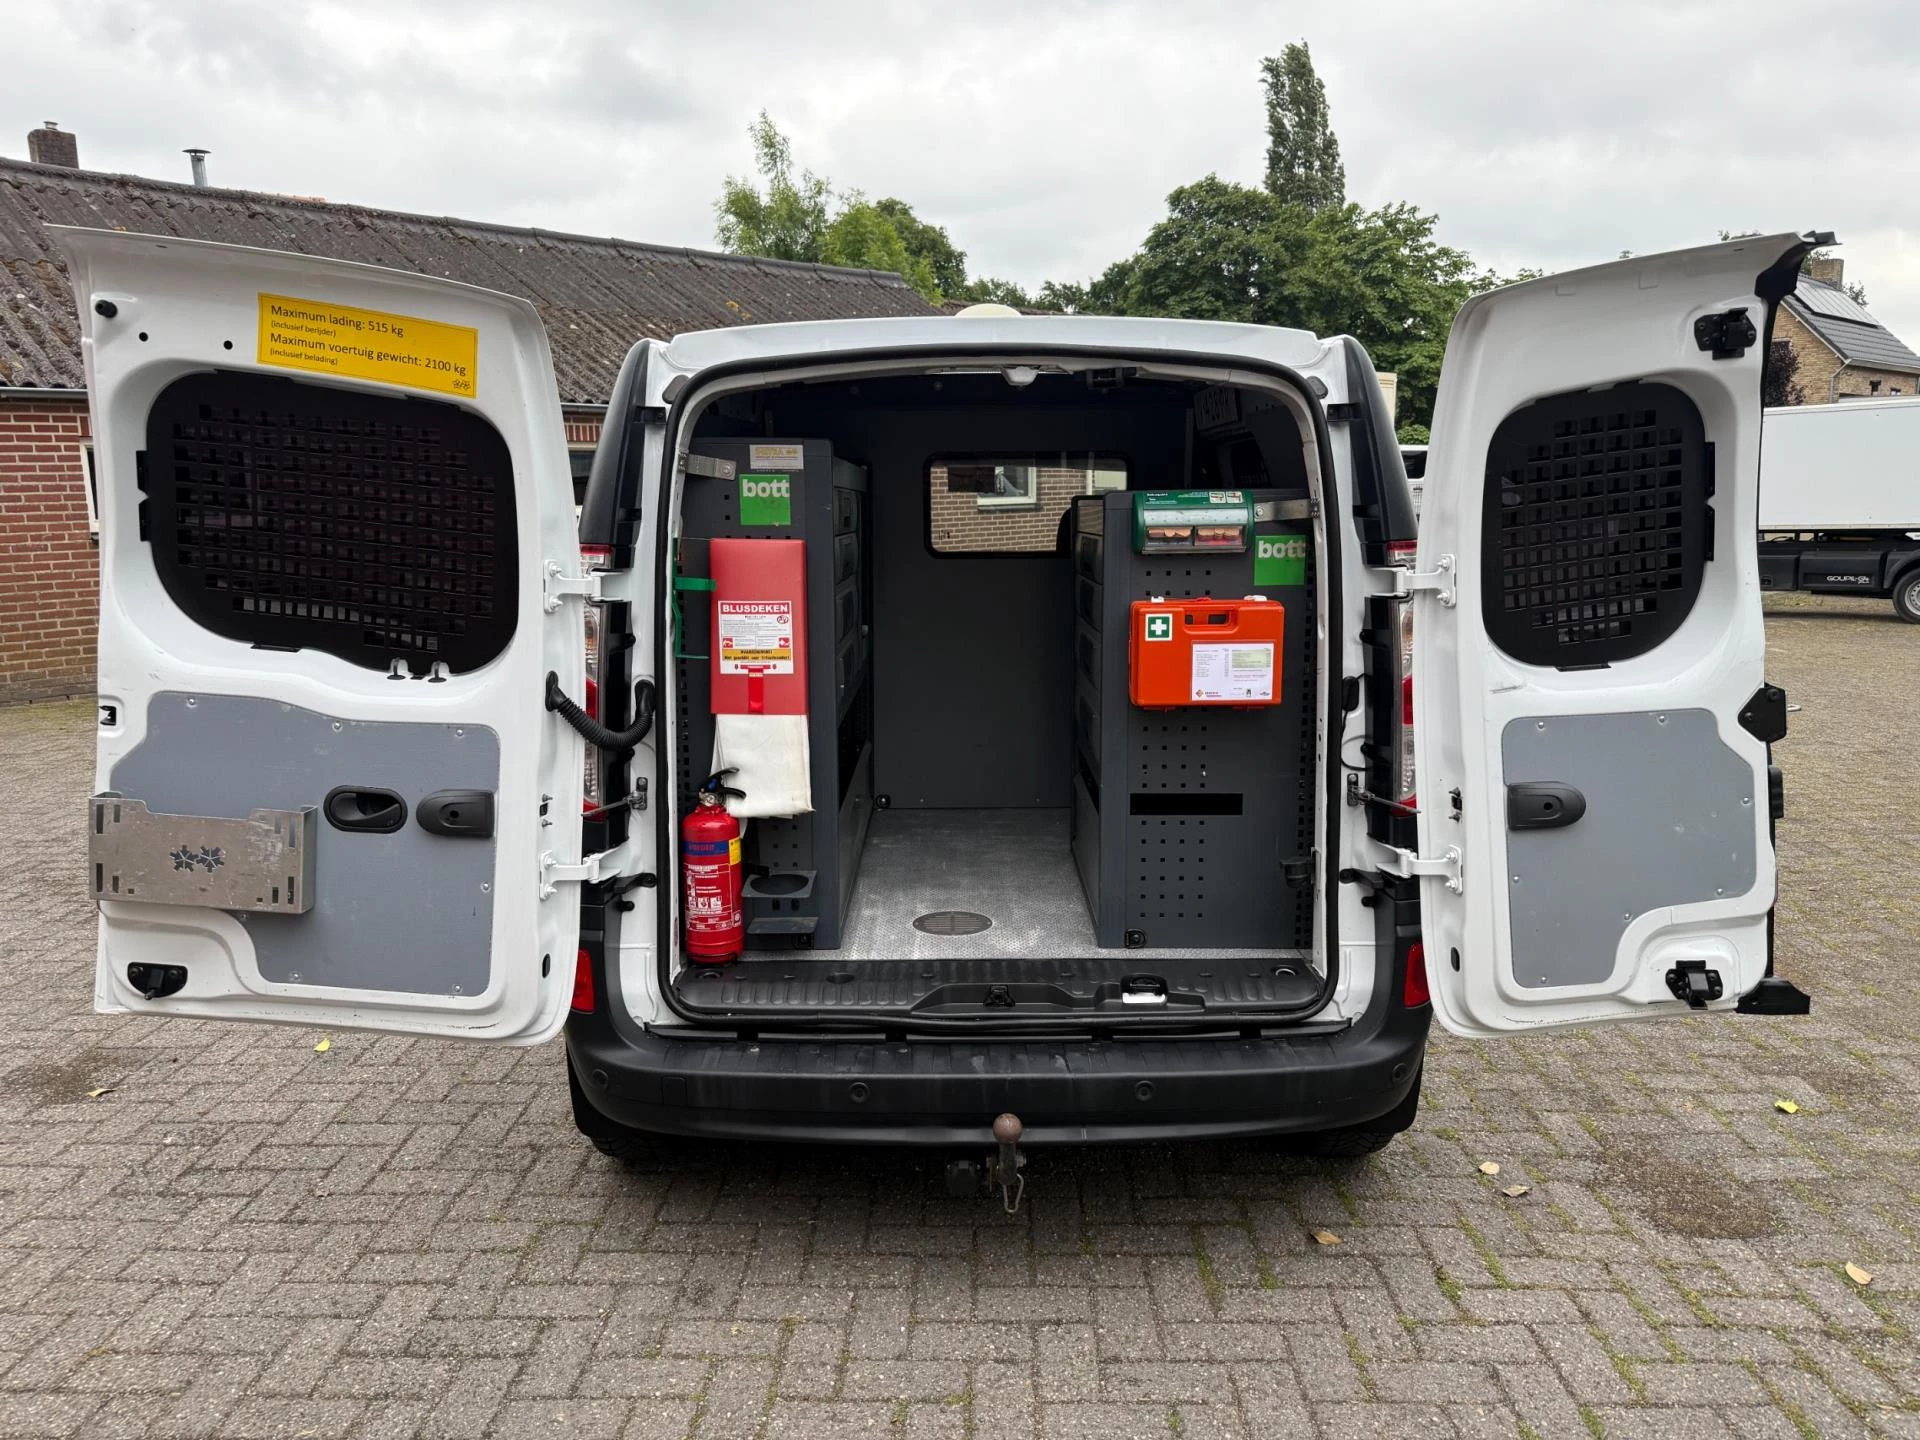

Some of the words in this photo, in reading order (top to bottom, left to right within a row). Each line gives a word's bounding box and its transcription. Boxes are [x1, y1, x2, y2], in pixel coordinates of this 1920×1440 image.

[271, 305, 326, 324] Maximum
[329, 312, 366, 330] lading:
[368, 319, 388, 333] 515
[391, 323, 404, 338] kg
[271, 320, 304, 333] (inclusief
[304, 326, 337, 338] berijder)
[270, 333, 326, 351] Maximum
[328, 343, 374, 361] voertuig
[376, 349, 422, 367] gewicht:
[424, 357, 451, 372] 2100
[454, 362, 466, 377] kg
[270, 348, 303, 361] (inclusief
[304, 352, 338, 366] belading)
[742, 479, 790, 498] bott
[1258, 540, 1306, 559] bott
[722, 604, 788, 613] BLUSDEKEN
